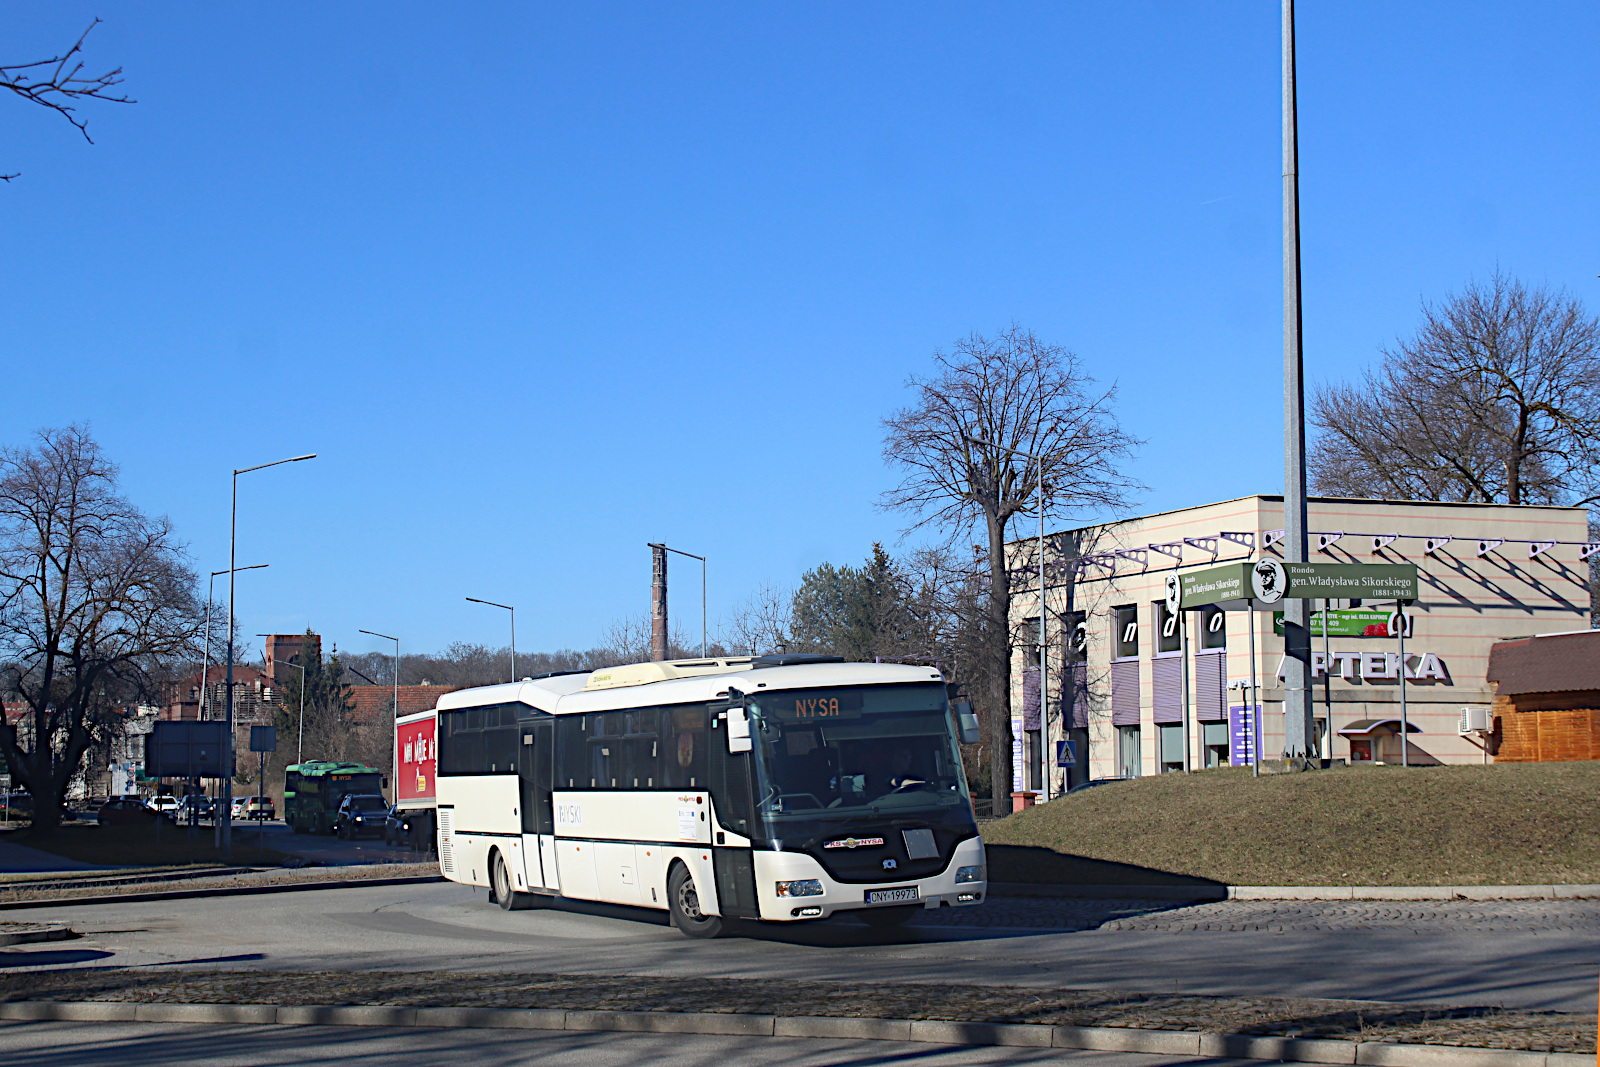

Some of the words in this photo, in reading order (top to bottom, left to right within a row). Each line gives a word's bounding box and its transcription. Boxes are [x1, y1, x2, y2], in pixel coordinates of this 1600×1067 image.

[1362, 576, 1412, 588] Sikorskiego
[1372, 589, 1412, 597] (1881-1943)
[796, 698, 839, 718] NYSA
[890, 889, 917, 901] 19973
